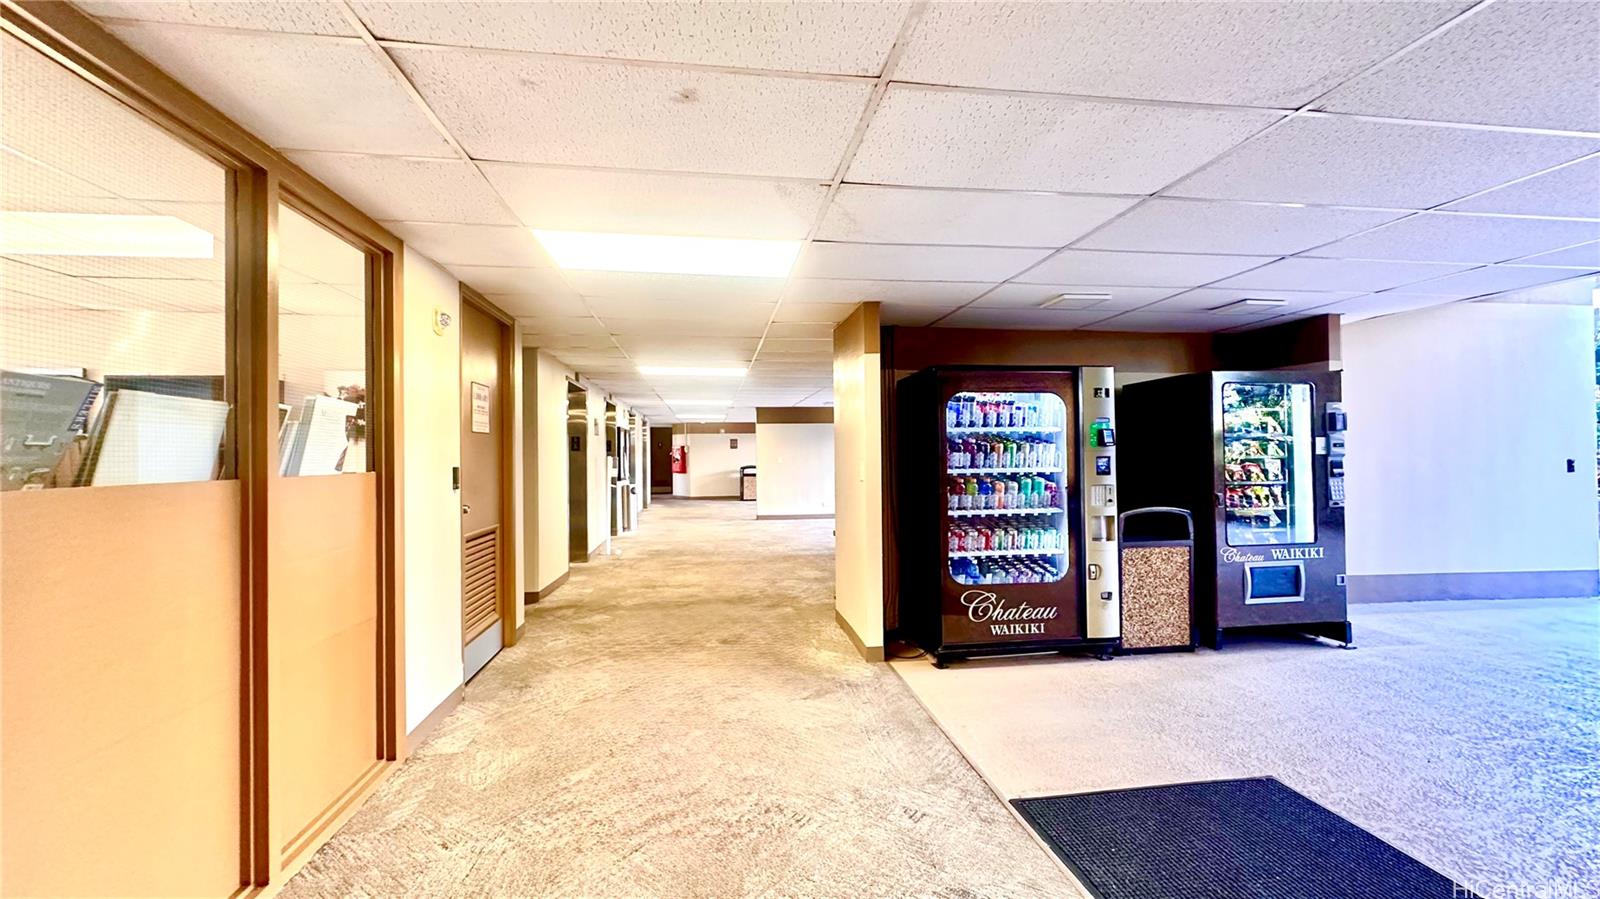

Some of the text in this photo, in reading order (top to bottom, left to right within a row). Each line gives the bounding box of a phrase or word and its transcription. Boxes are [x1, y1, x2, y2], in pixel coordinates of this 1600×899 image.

[1220, 547, 1324, 562] Chateau WAIKIKI
[961, 590, 1057, 622] Chateau
[991, 623, 1044, 635] WAIKIKI
